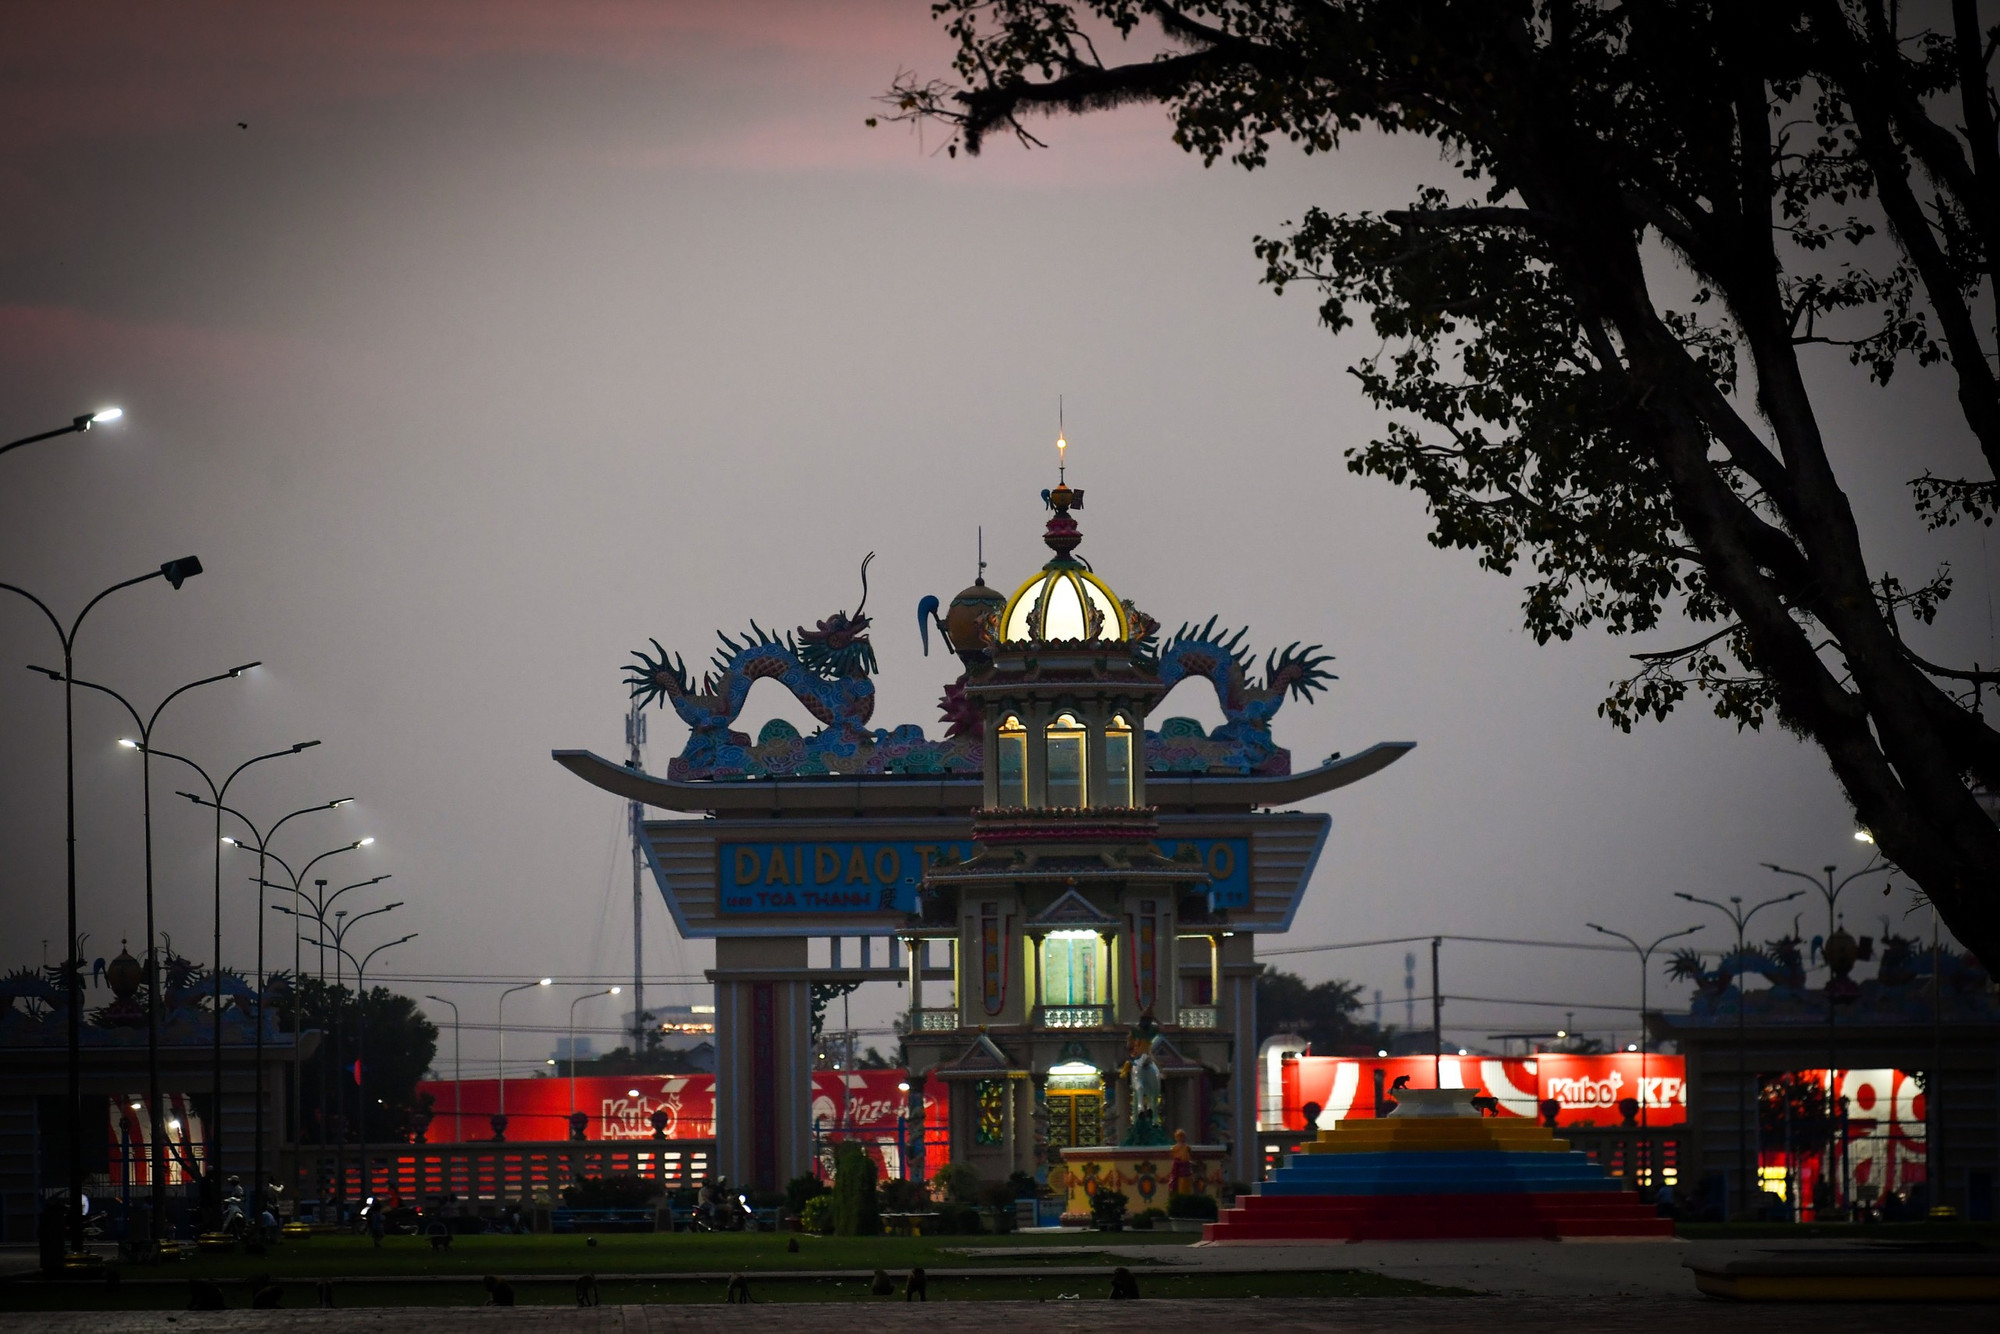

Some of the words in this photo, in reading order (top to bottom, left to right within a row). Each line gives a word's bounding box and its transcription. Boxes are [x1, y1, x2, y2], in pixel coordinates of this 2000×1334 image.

[1548, 1077, 1617, 1108] Kubo
[602, 1097, 678, 1136] Kubo
[842, 1097, 892, 1129] Pizza
